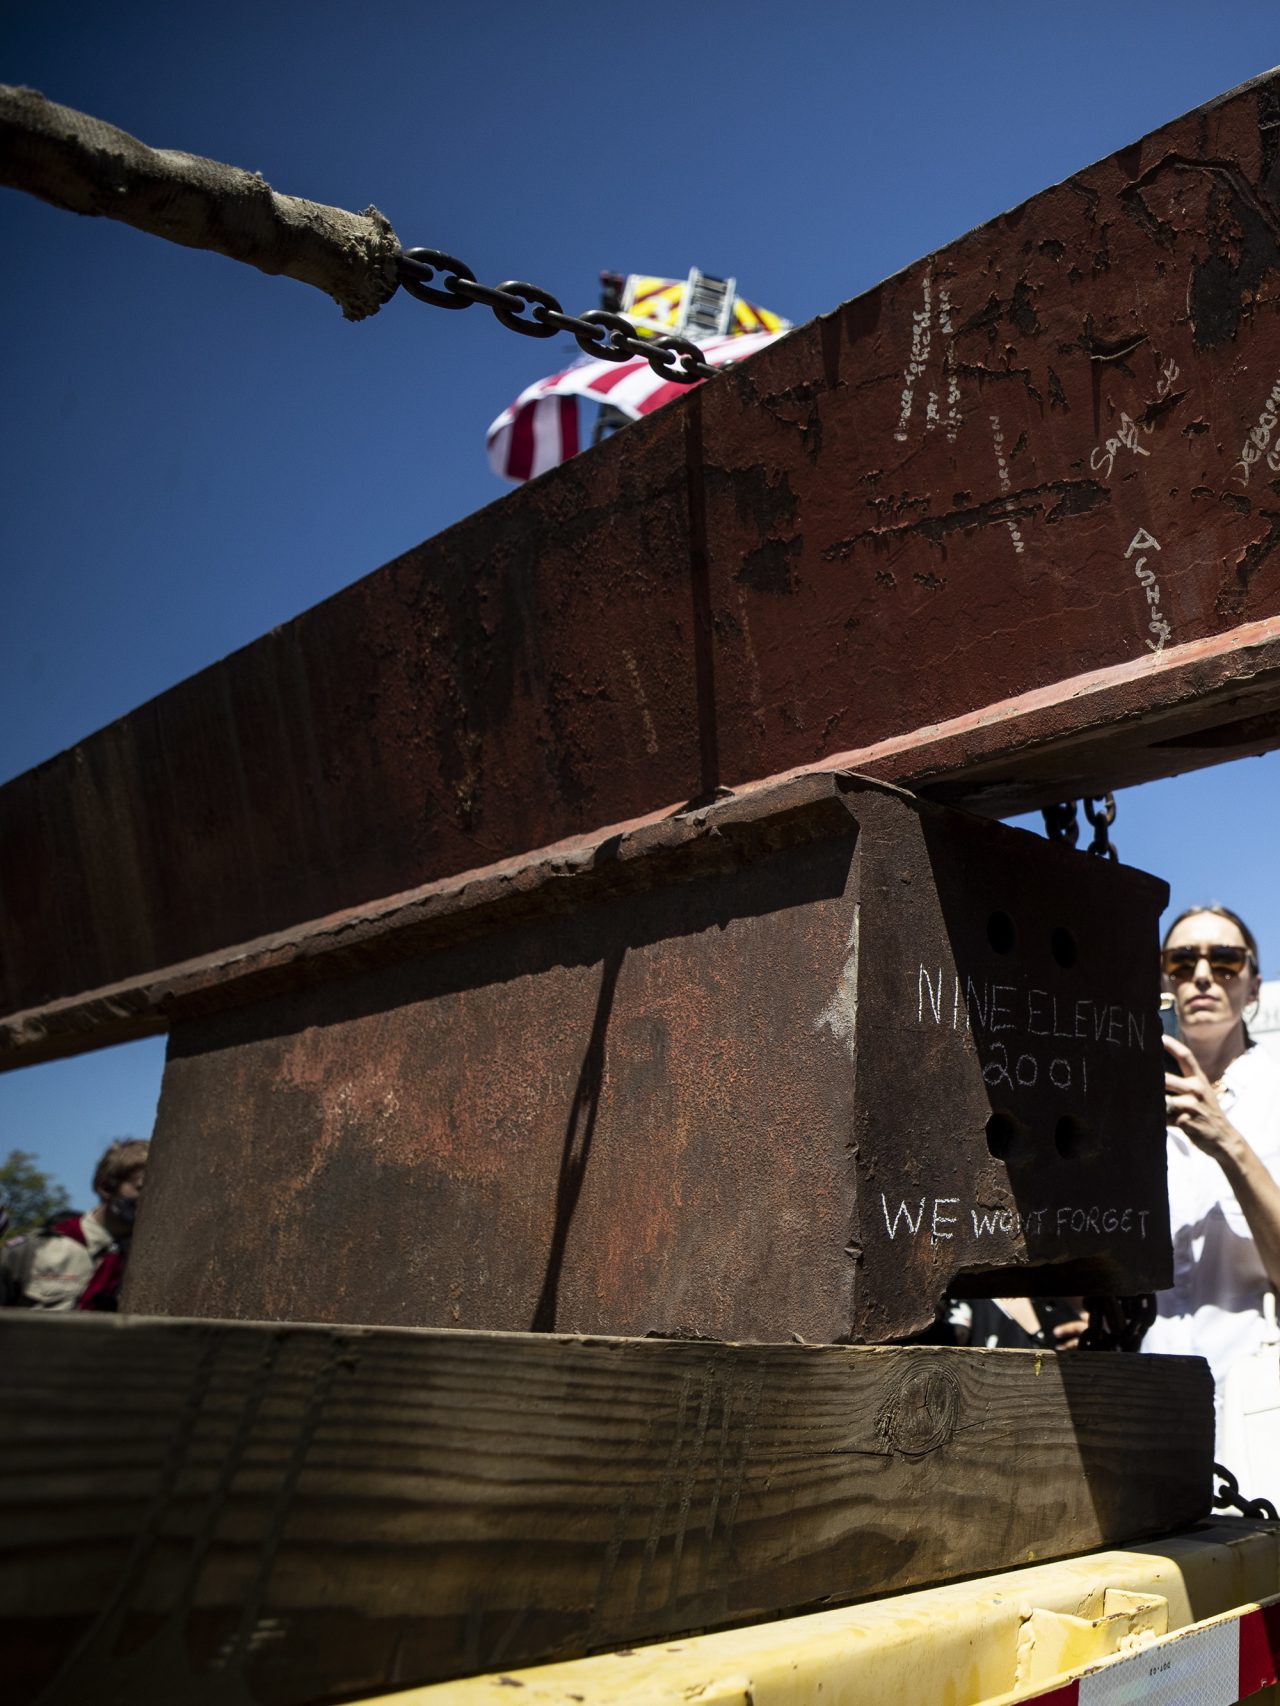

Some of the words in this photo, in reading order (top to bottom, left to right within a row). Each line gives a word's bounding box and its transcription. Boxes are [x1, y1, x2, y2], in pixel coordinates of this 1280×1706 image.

[917, 963, 1017, 1033] NINE
[1027, 988, 1145, 1051] ELEVEN
[982, 1041, 1088, 1093] 2001
[881, 1193, 960, 1240] WE
[1056, 1206, 1150, 1240] FORGET
